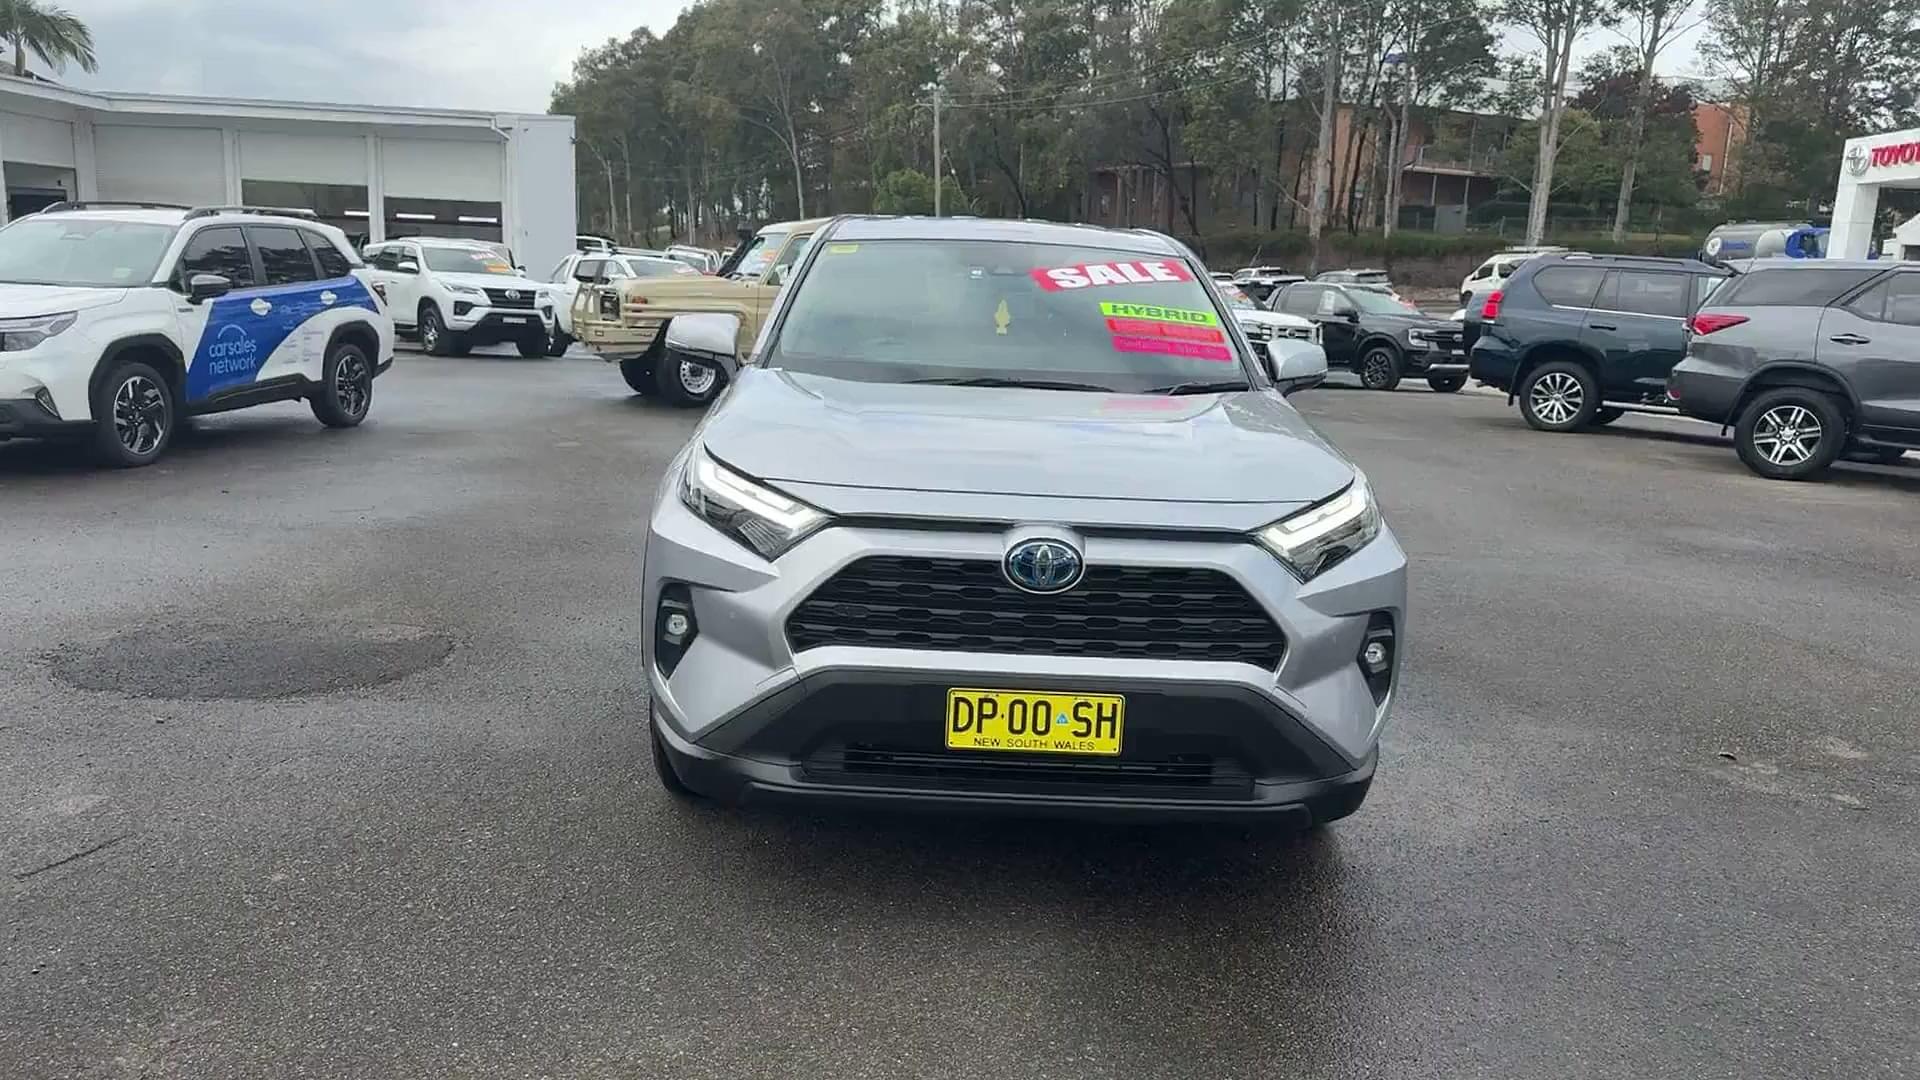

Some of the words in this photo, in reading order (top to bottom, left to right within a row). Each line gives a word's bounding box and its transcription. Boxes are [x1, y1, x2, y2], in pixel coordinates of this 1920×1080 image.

[1047, 262, 1180, 288] SALE
[1111, 304, 1208, 323] HYBRID
[209, 335, 257, 358] carsales
[209, 353, 257, 375] network
[974, 737, 1000, 746] NEW
[1007, 738, 1047, 748] SOUTH
[1054, 740, 1095, 750] WALES
